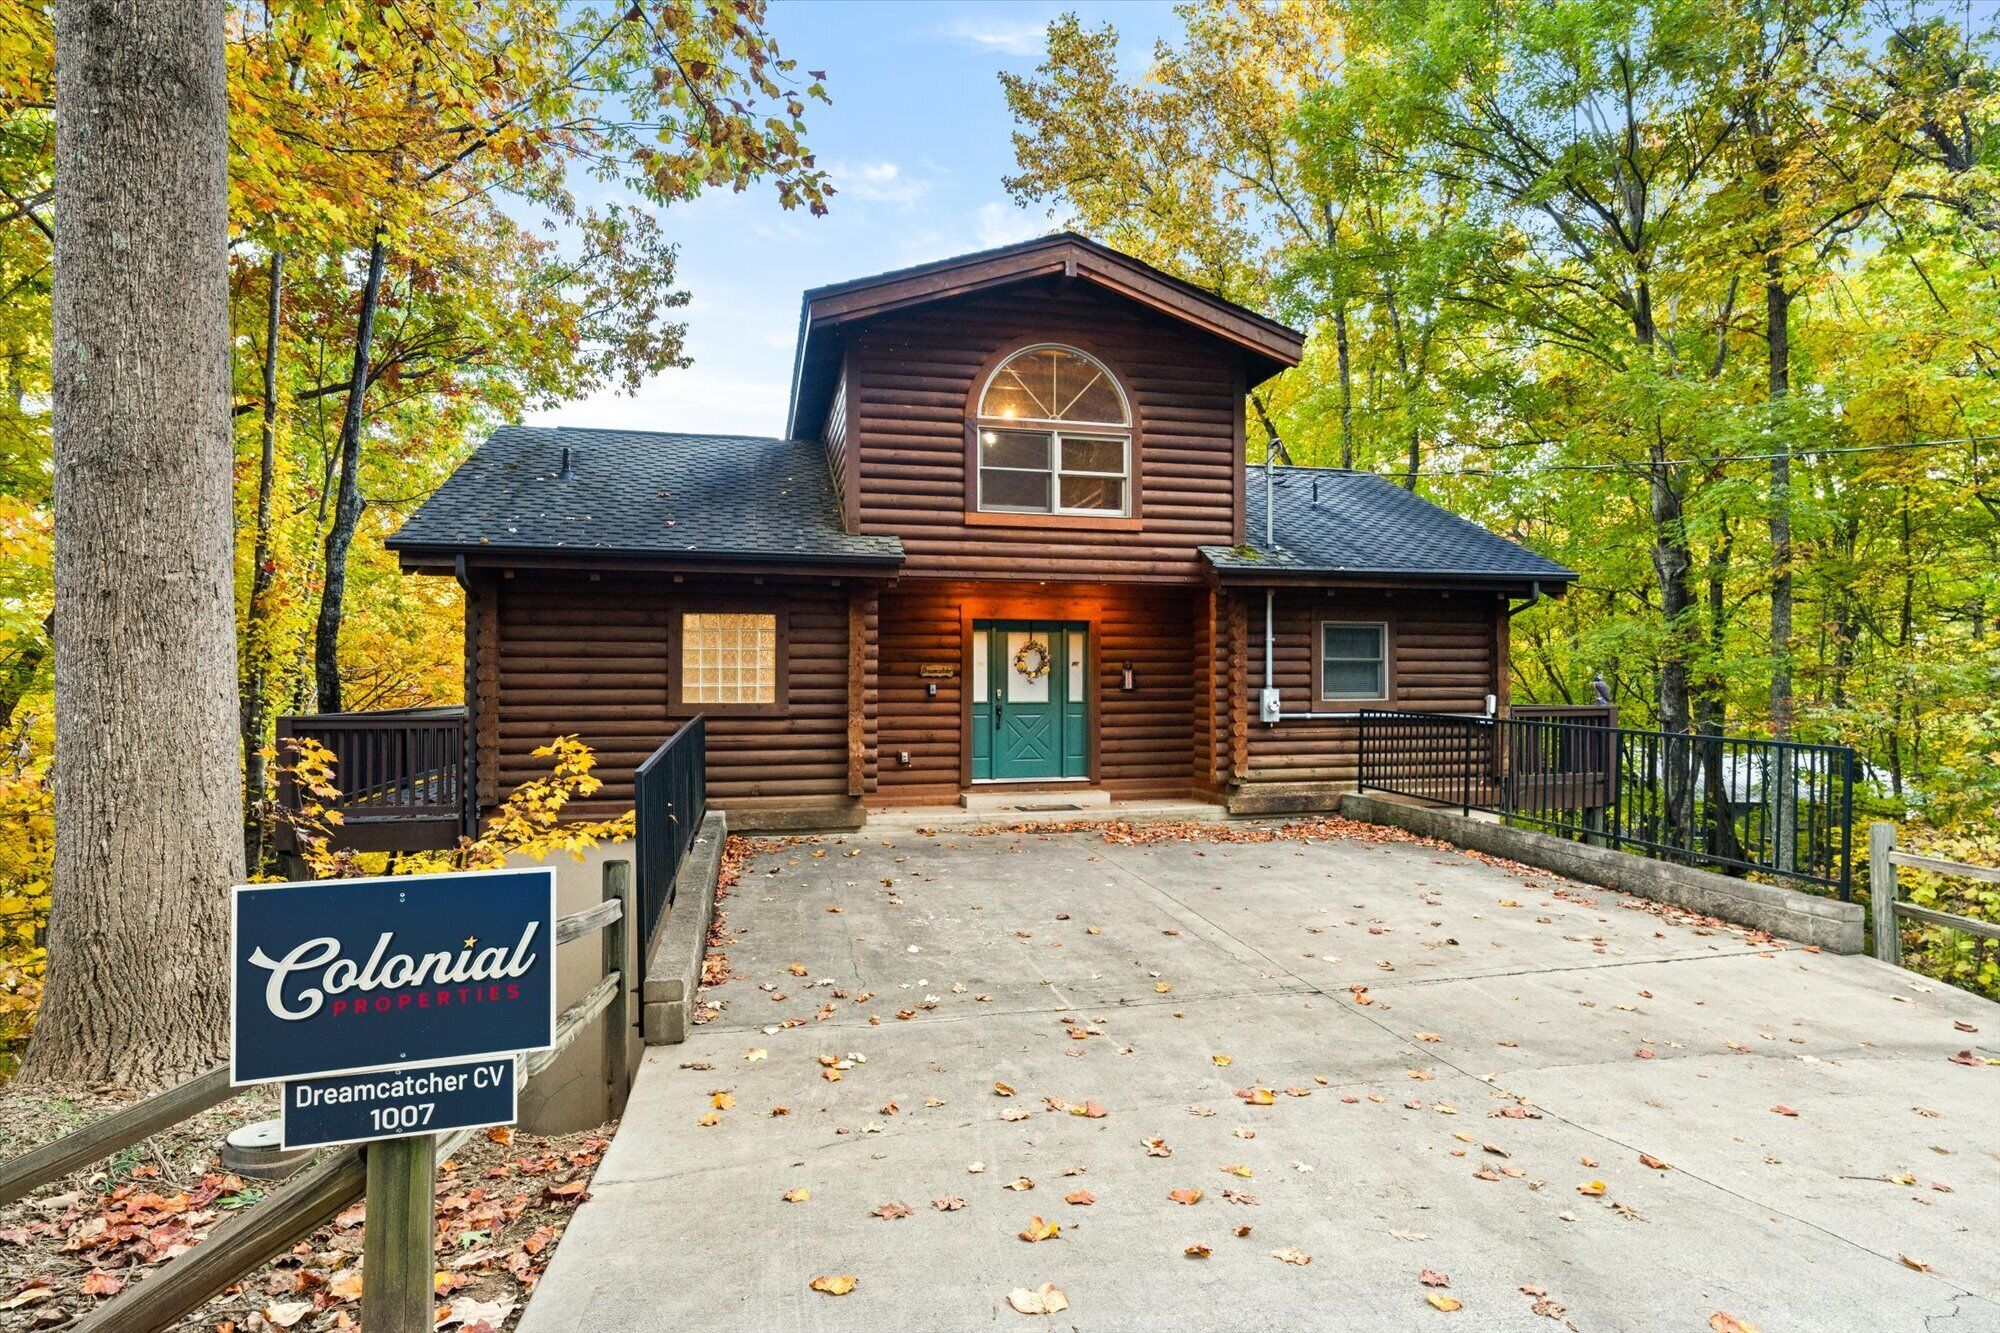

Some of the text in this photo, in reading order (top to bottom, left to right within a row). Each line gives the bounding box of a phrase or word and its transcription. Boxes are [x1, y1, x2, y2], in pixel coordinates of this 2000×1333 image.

[248, 921, 540, 1021] Colonial
[332, 984, 521, 1017] PROPERTIES
[296, 1065, 505, 1108] Dreamcatcher CV
[370, 1103, 435, 1131] 1007
